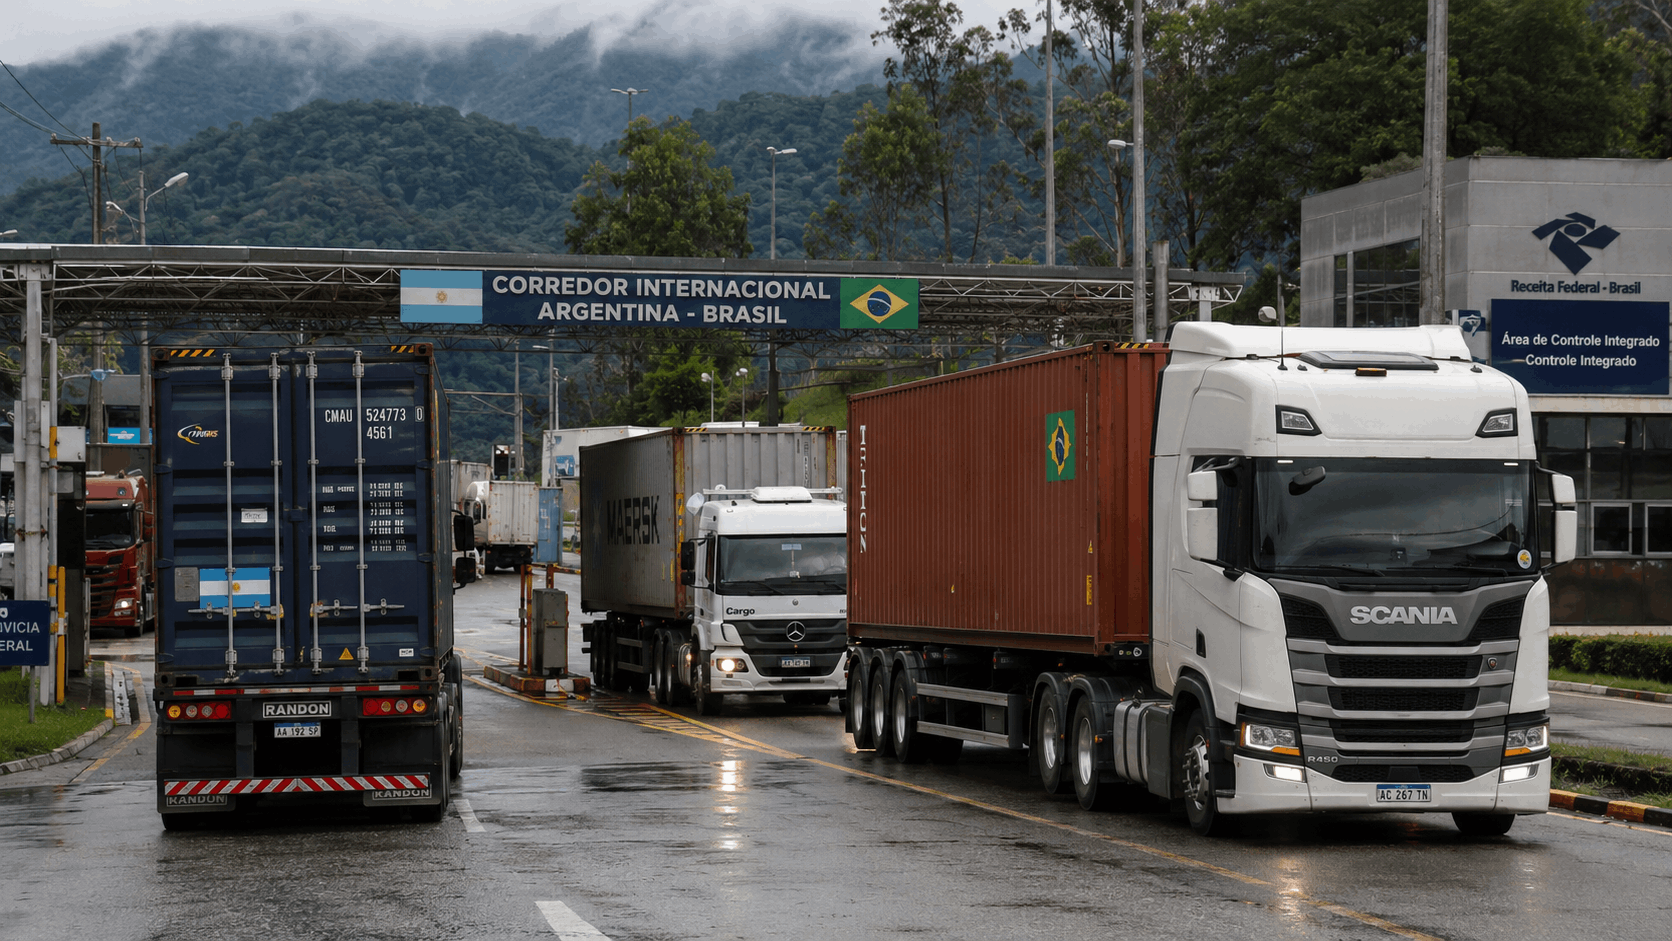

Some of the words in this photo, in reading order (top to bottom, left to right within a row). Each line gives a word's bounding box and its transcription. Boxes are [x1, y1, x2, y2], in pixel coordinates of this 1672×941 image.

[492, 275, 628, 296] CORREDOR
[636, 278, 831, 299] INTERNACIONAL
[1511, 280, 1554, 293] Receita
[1557, 281, 1600, 293] Federal
[1609, 281, 1641, 294] Brasil
[537, 302, 679, 323] ARGENTINA
[703, 304, 787, 324] BRASIL
[1502, 331, 1529, 345] Área
[1533, 334, 1548, 345] de
[1551, 334, 1601, 346] Controle
[1605, 335, 1660, 349] Integrado
[1525, 354, 1577, 366] Controle
[1581, 355, 1637, 369] Integrado
[325, 409, 353, 423] CMAU
[366, 408, 406, 422] 524773
[366, 425, 392, 440] 4561
[607, 495, 660, 546] MAERSK
[726, 607, 756, 616] Cargo
[1350, 605, 1458, 625] SCANIA
[266, 703, 329, 716] RANDON
[277, 728, 288, 737] AA
[291, 727, 305, 737] 192
[1380, 790, 1392, 800] AC
[1396, 790, 1413, 800] 267
[1417, 790, 1428, 800] TN
